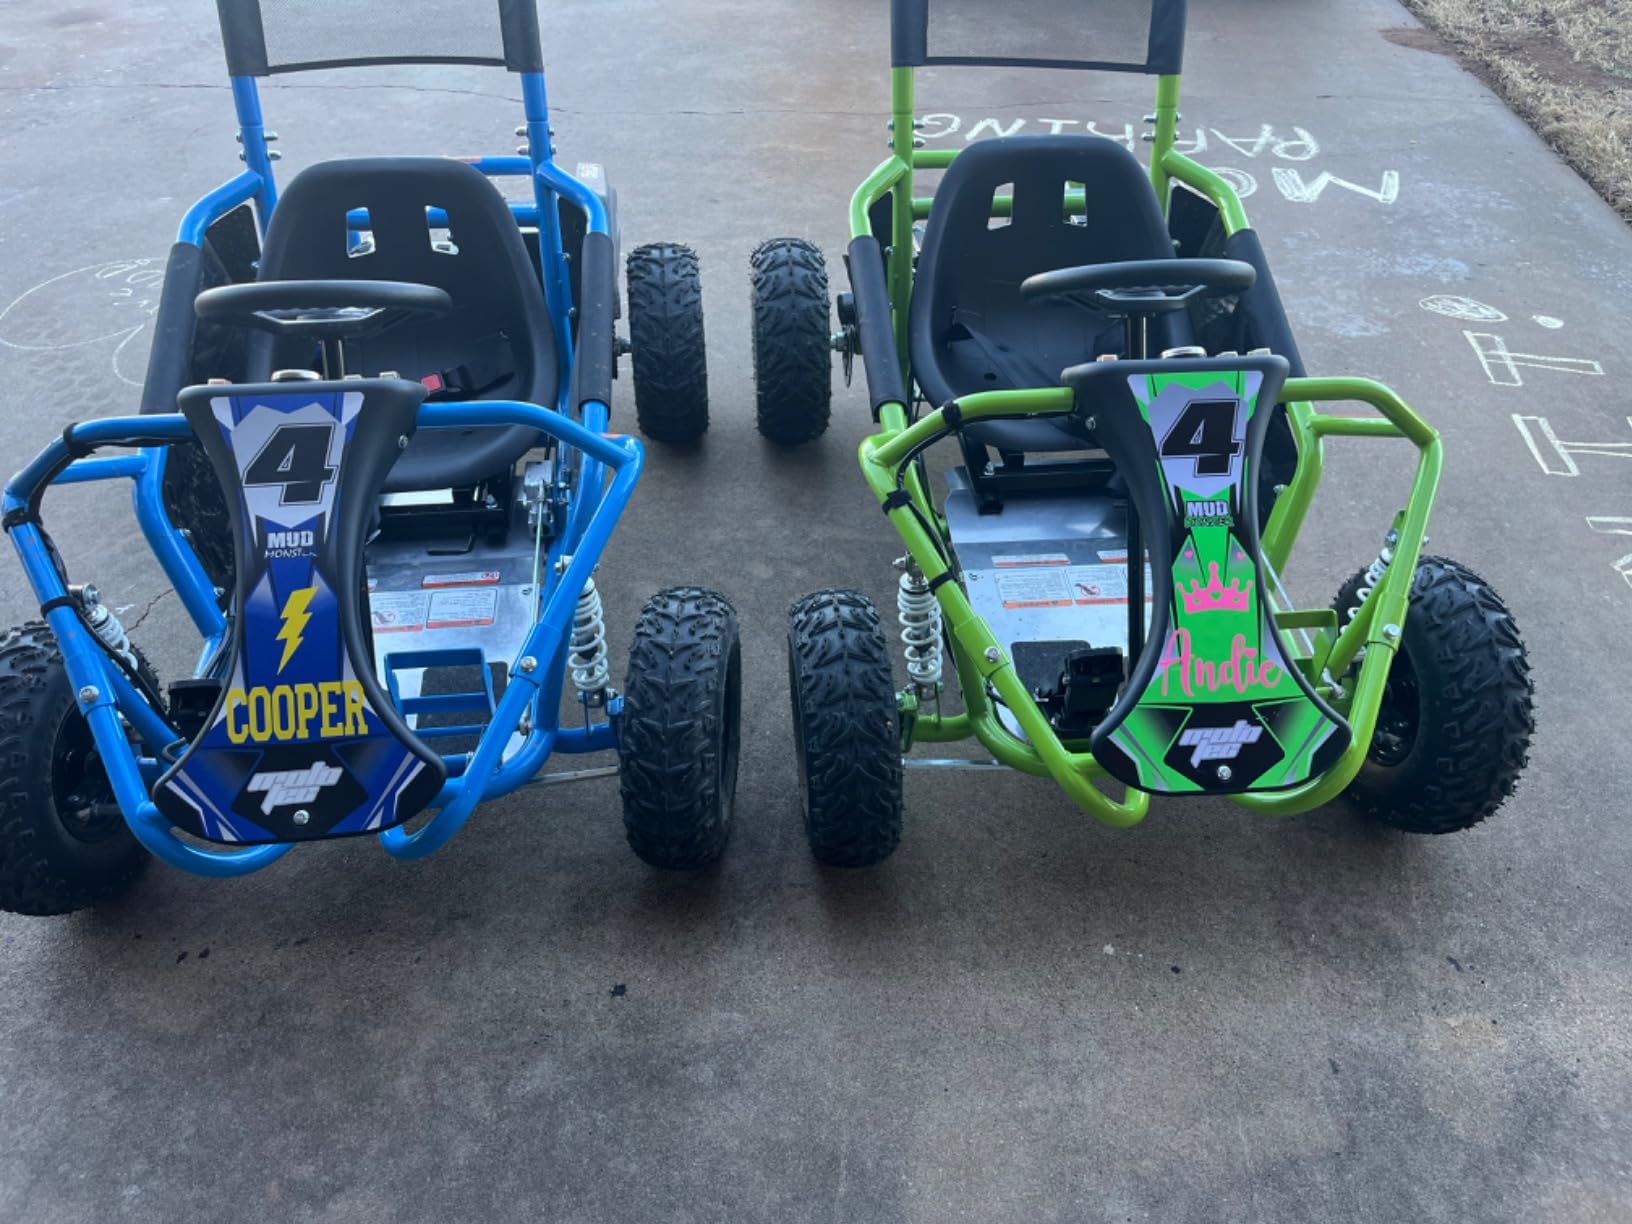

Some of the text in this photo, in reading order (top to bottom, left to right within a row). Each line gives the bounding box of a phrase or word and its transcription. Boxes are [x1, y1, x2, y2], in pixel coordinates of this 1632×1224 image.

[242, 422, 339, 507] 4
[1159, 398, 1244, 478] 4
[267, 531, 314, 549] MUD
[1186, 500, 1229, 517] MUD
[1158, 627, 1284, 697] Andie
[225, 680, 369, 744] COOPER
